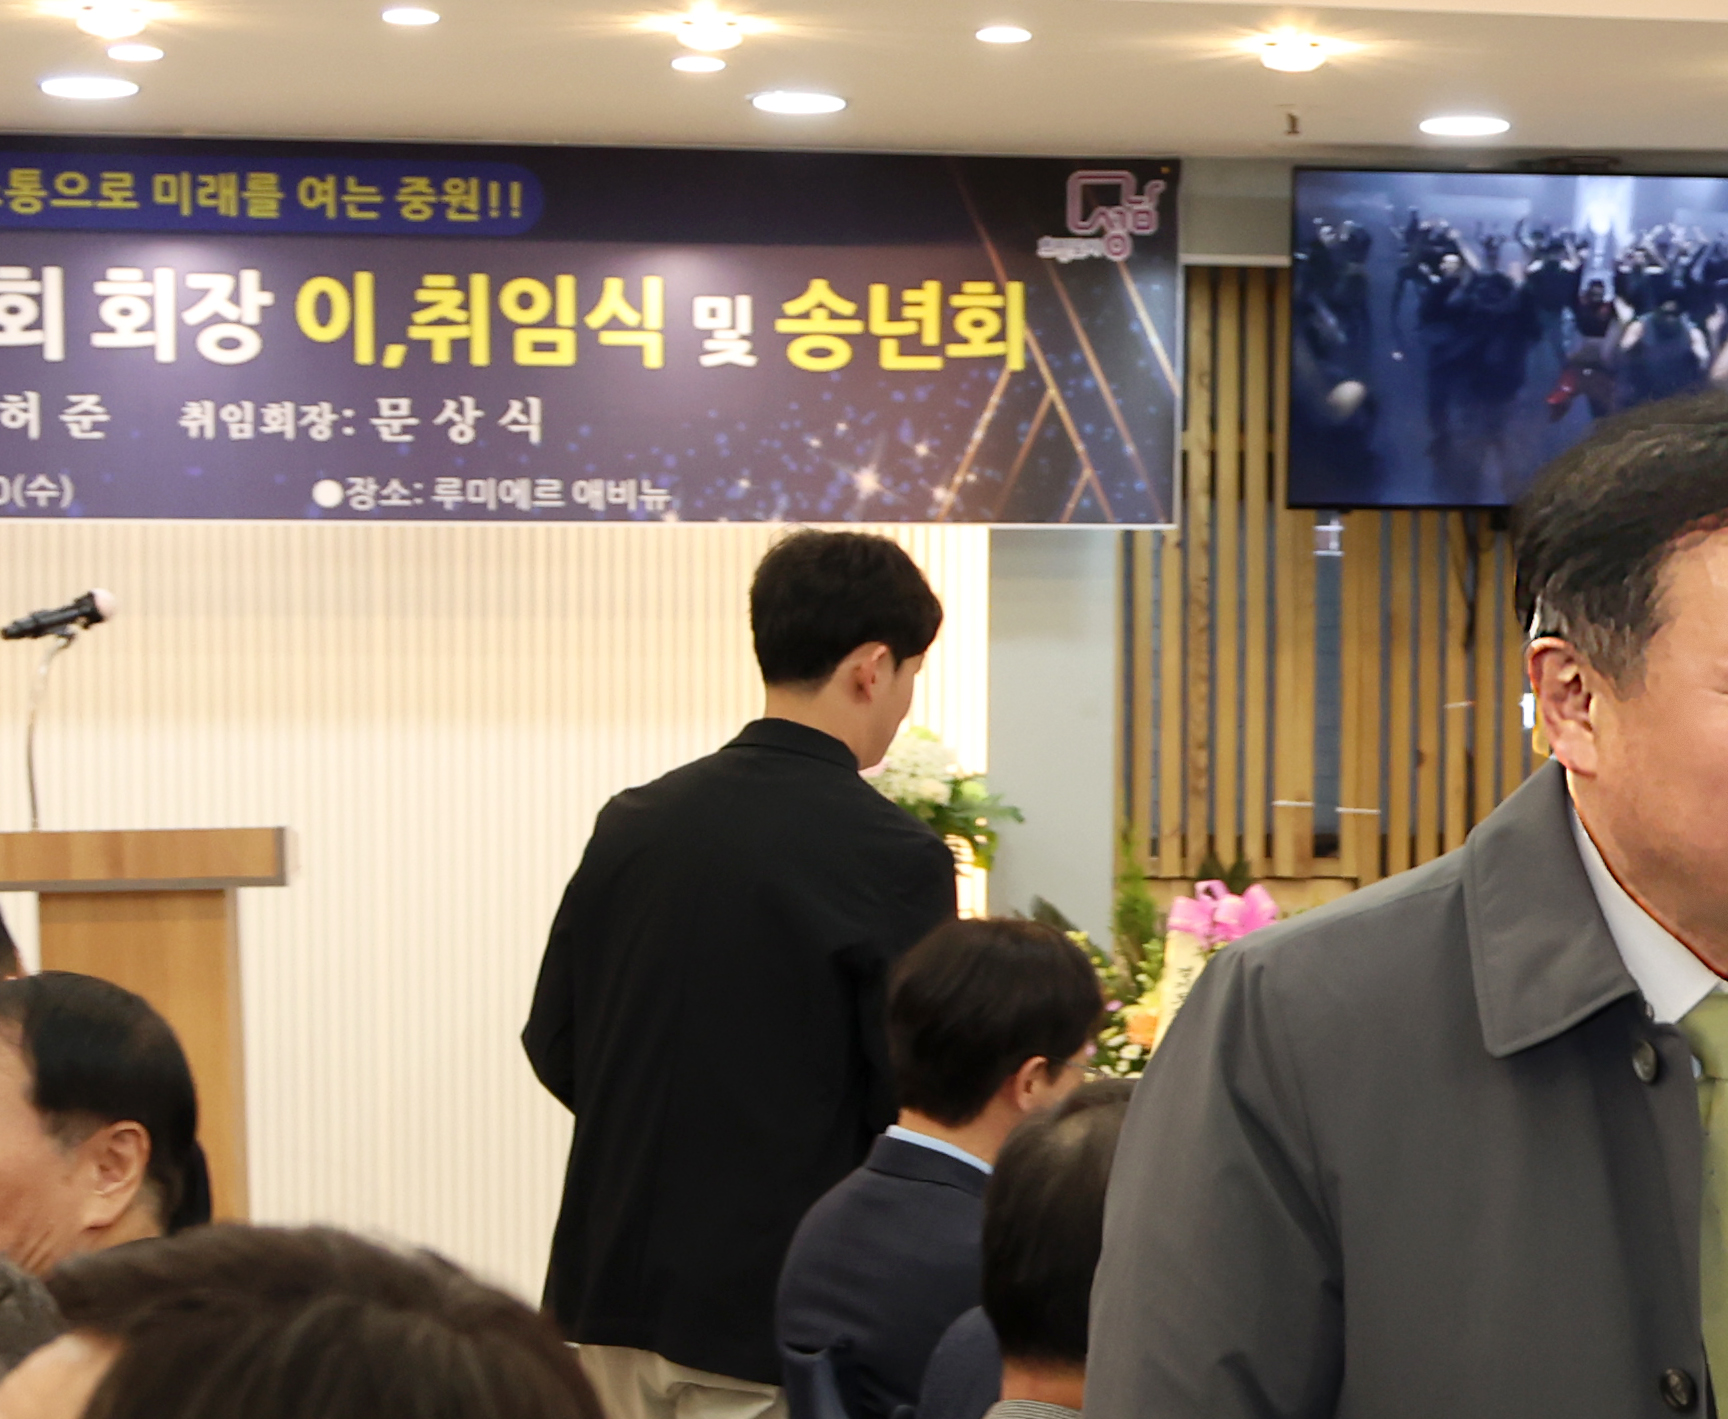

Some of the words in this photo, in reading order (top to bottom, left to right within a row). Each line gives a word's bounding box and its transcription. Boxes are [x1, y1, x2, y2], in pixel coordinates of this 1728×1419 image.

[0, 167, 141, 216] 통으로
[152, 170, 286, 220] 미래를
[297, 173, 384, 220] 여는
[395, 175, 523, 222] 중원!!
[90, 267, 276, 365] 회장
[295, 270, 665, 370] 이,취임식
[692, 294, 758, 368] 및
[774, 277, 1027, 372] 송년회
[178, 399, 357, 442] 취임회장:
[430, 476, 567, 513] 루미에르
